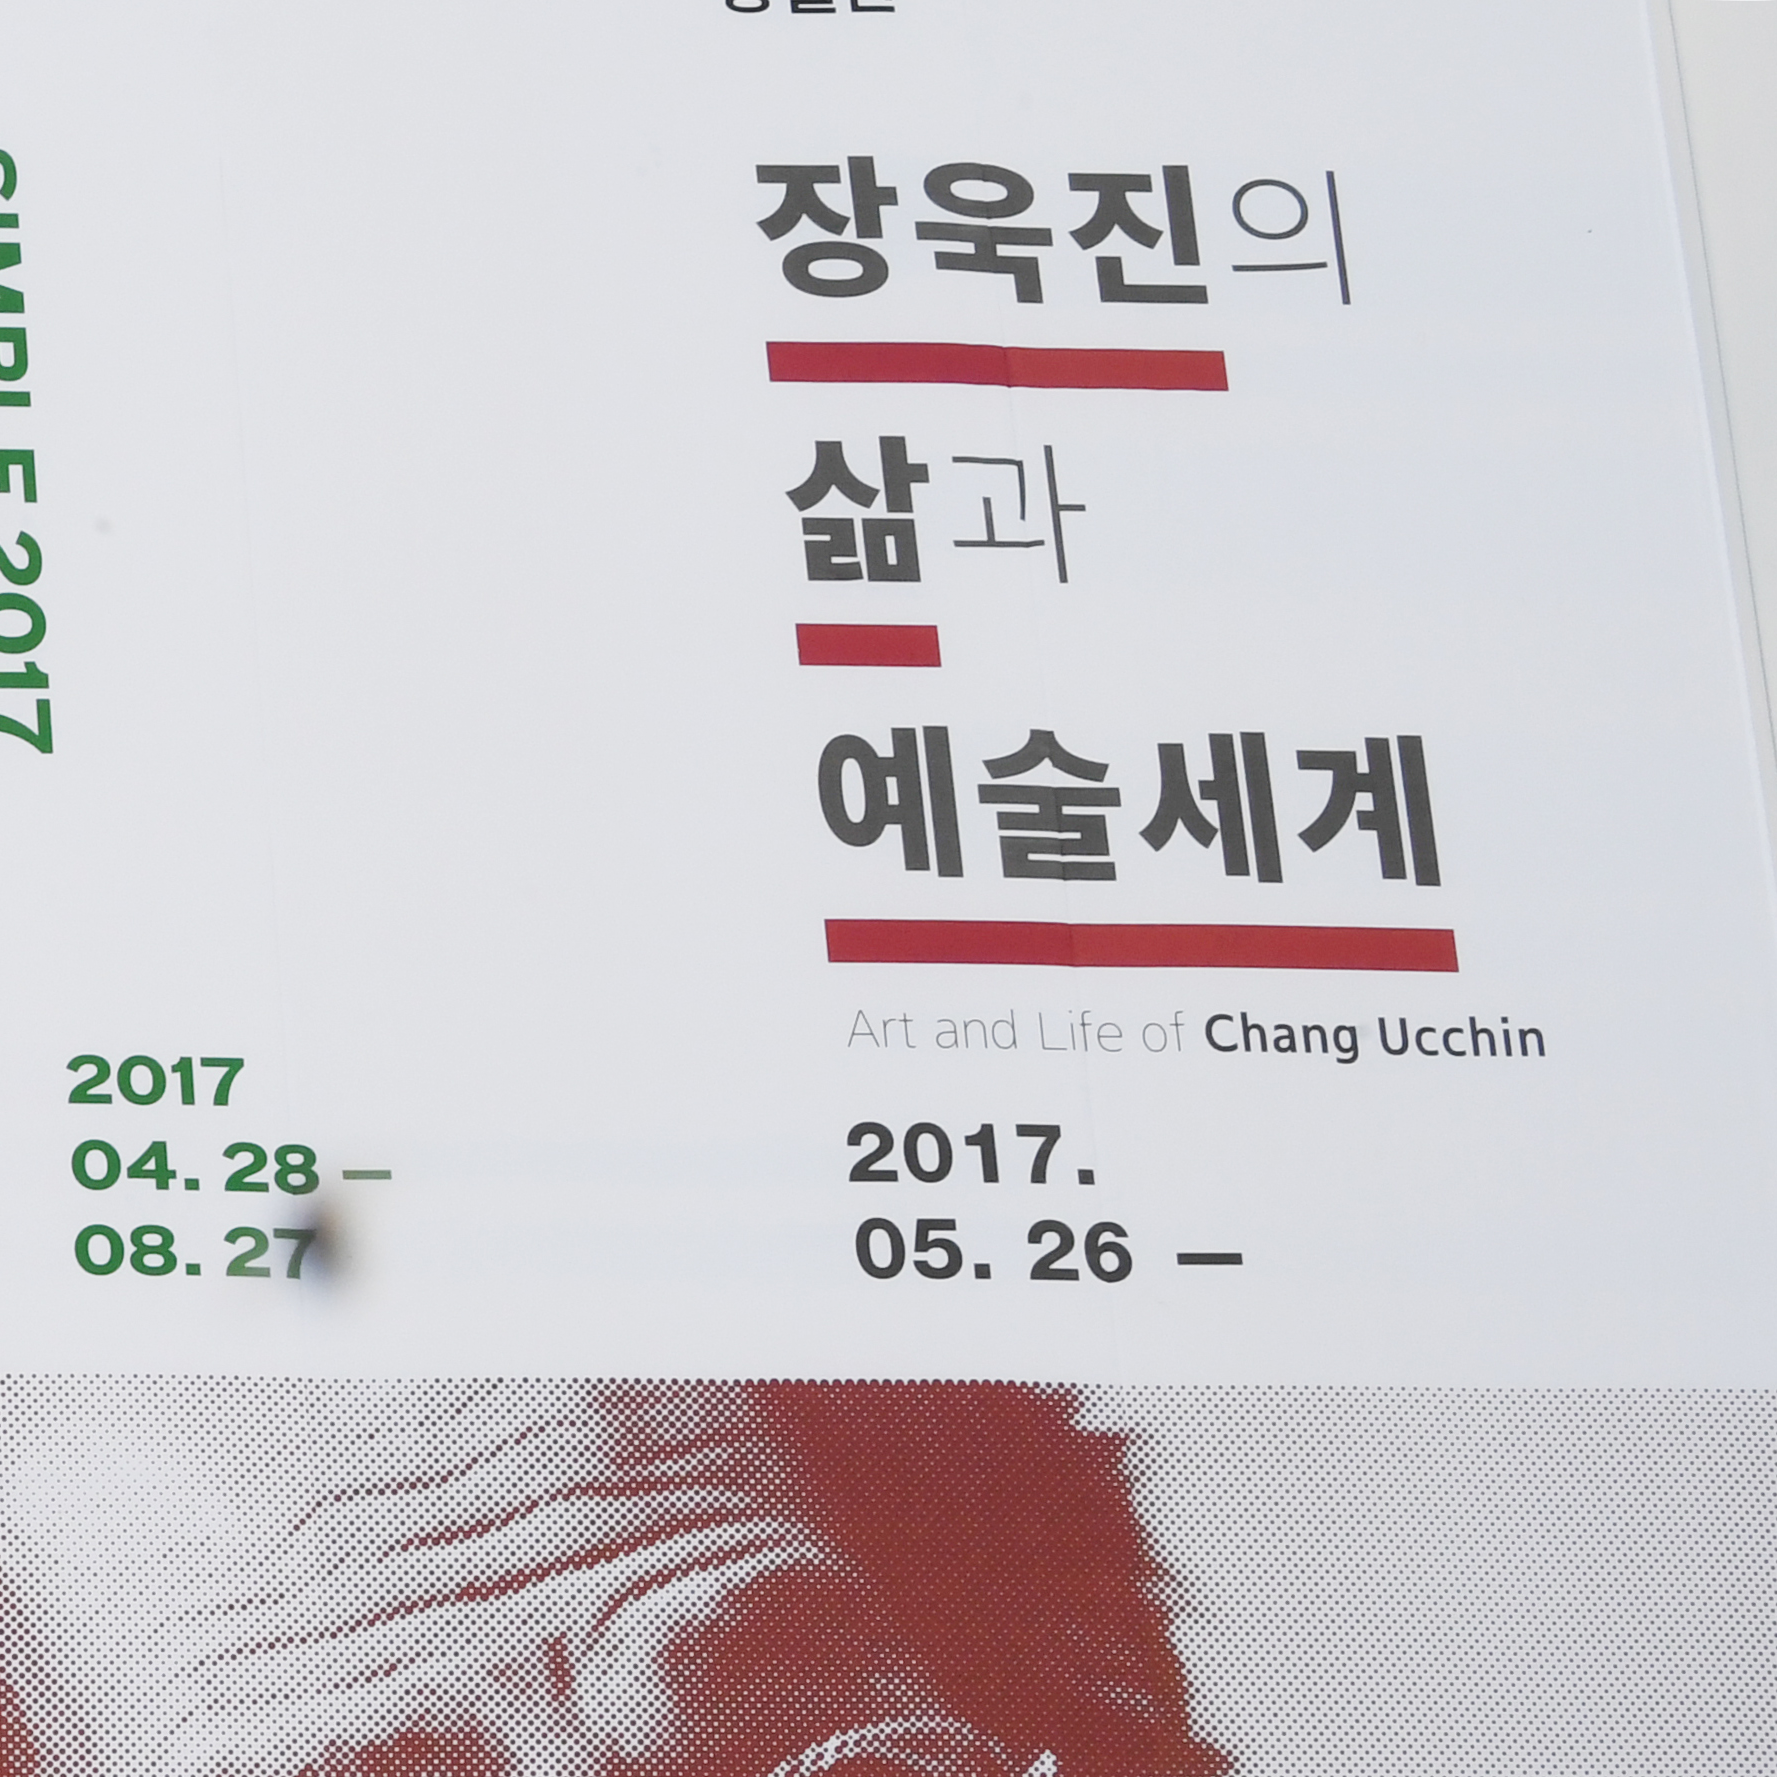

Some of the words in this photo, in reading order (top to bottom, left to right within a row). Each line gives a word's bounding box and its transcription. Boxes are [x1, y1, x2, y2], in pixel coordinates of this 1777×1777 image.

[755, 155, 1352, 306] 장욱진의
[784, 435, 1087, 584] 삶과
[817, 725, 1442, 888] 예술세계
[847, 1009, 917, 1050] Art
[935, 1008, 1018, 1050] and
[1038, 1009, 1123, 1053] Life
[1141, 1010, 1186, 1053] of
[1204, 1011, 1360, 1065] Chang
[1377, 1015, 1546, 1058] Ucchin
[66, 1054, 245, 1106] 2017
[71, 1139, 201, 1192] 04.
[223, 1141, 320, 1195] 28
[846, 1121, 1096, 1186] 2017.
[73, 1223, 203, 1277] 08.
[854, 1217, 992, 1281] 05.
[1027, 1219, 1134, 1284] 26
